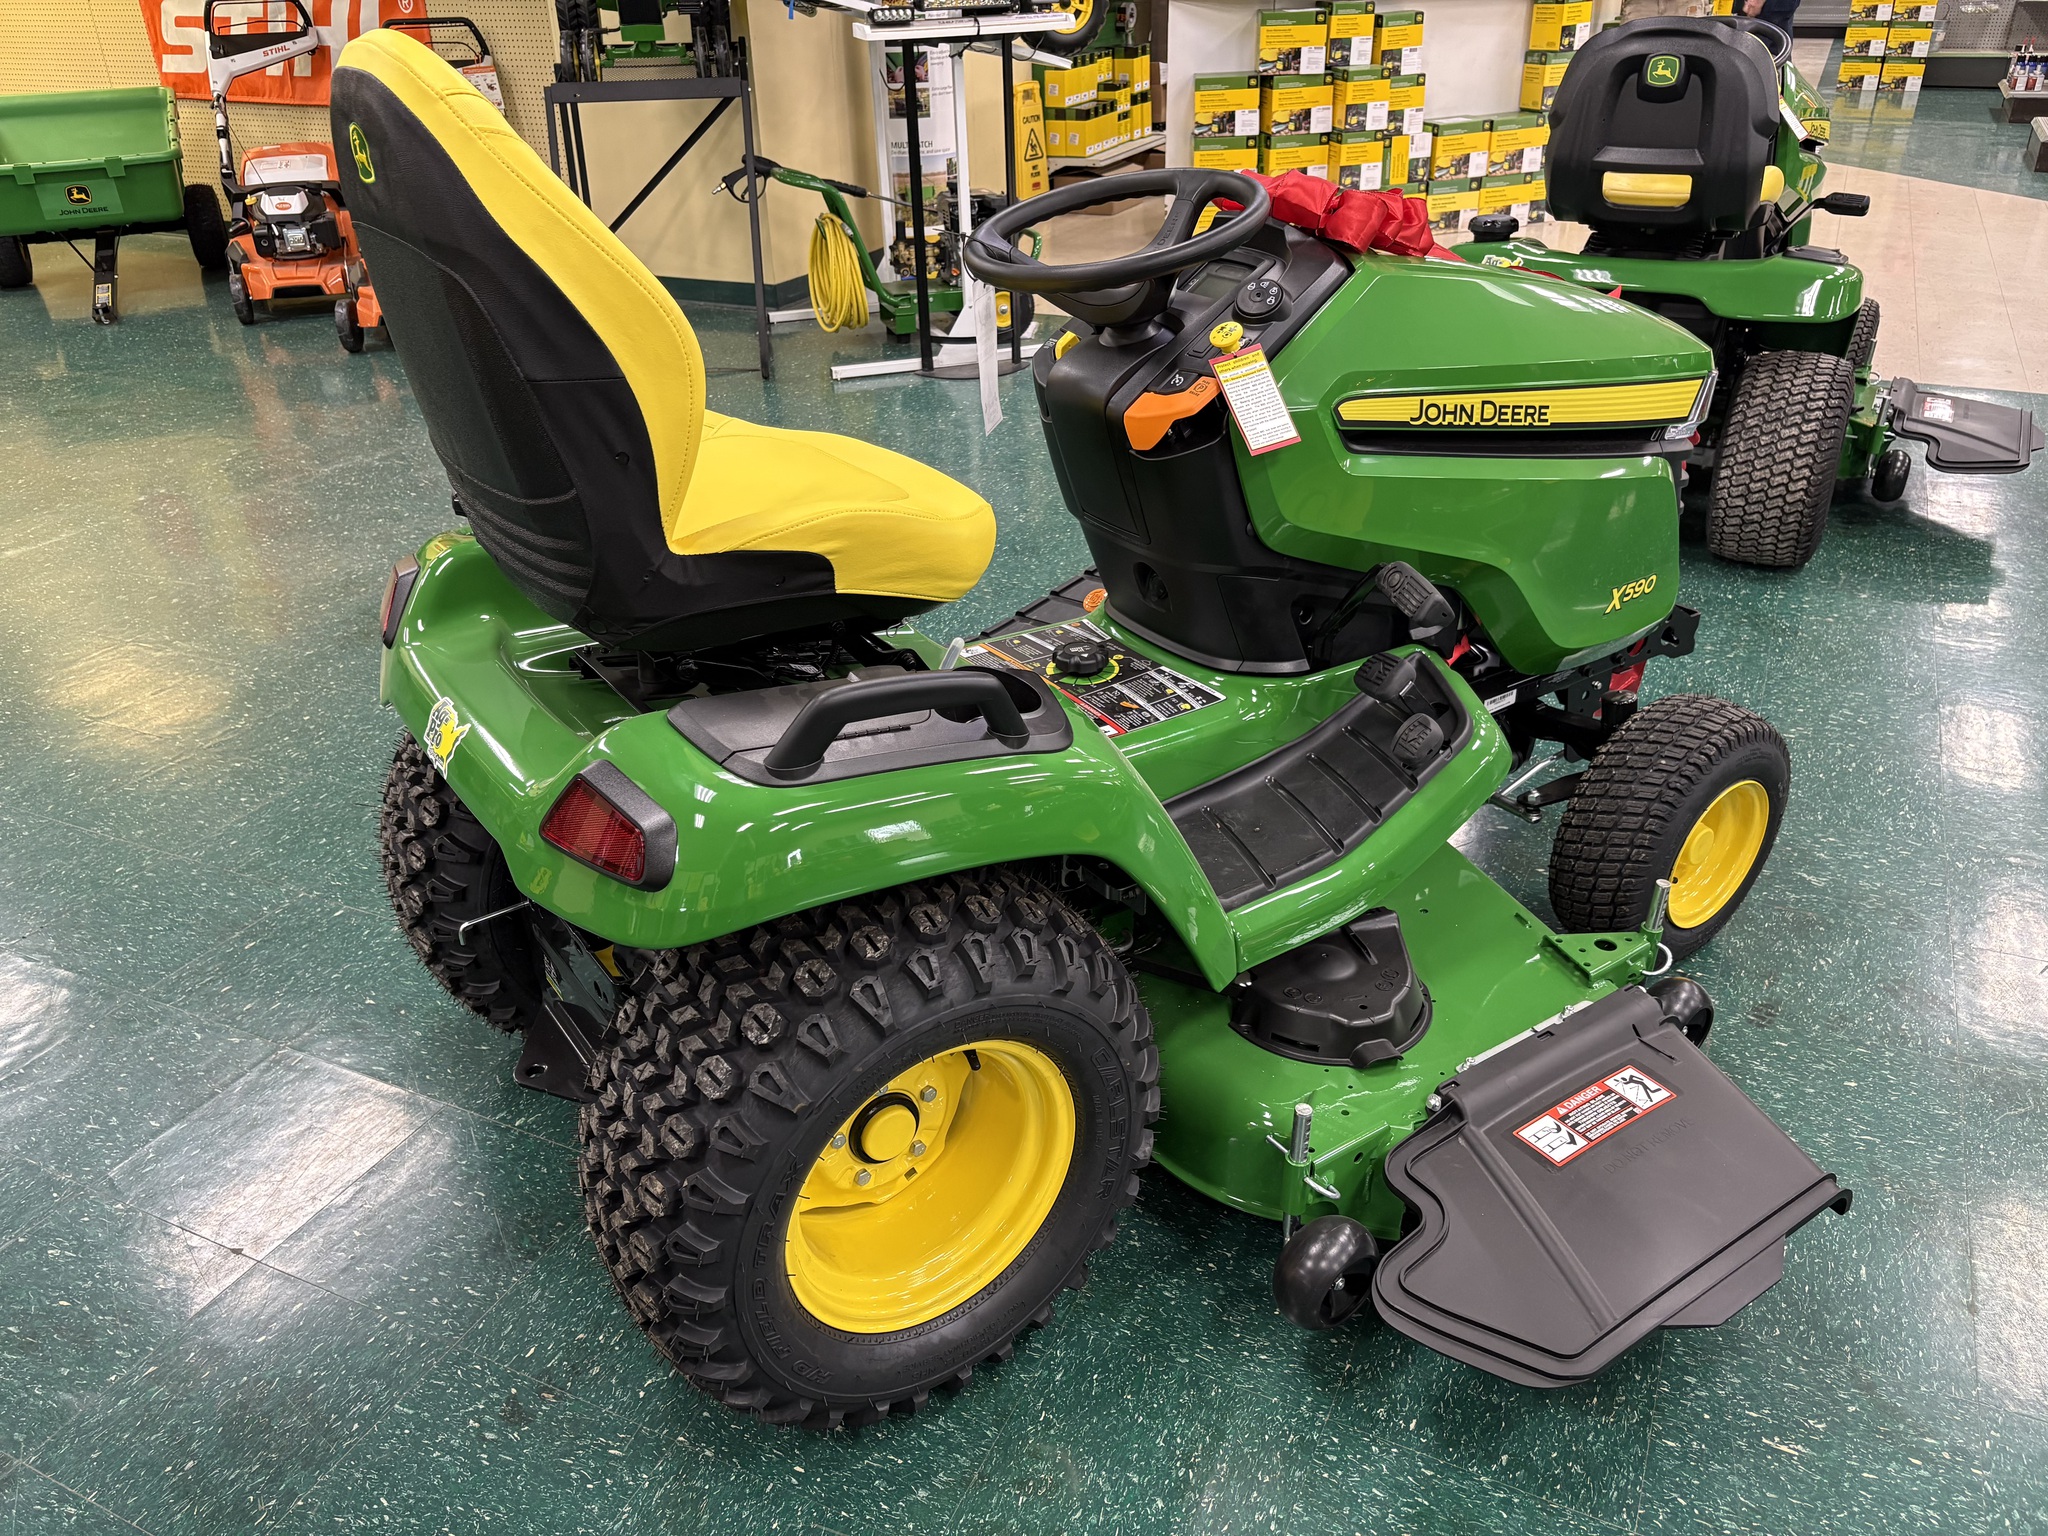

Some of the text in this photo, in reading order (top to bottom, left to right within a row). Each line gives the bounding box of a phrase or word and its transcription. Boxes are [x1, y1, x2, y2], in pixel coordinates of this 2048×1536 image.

[262, 45, 290, 57] STIHL
[1022, 115, 1040, 124] CAUTION
[59, 206, 109, 216] JOHN DEERE
[1216, 361, 1230, 369] Protect
[1410, 399, 1550, 424] JOHN DEERE
[1603, 573, 1658, 615] X590
[428, 718, 441, 747] Pro
[1563, 1085, 1602, 1109] DANGER
[1601, 1156, 1625, 1177] DO
[1621, 1140, 1649, 1163] NOT
[752, 1155, 834, 1385] HD FIELD TRAX
